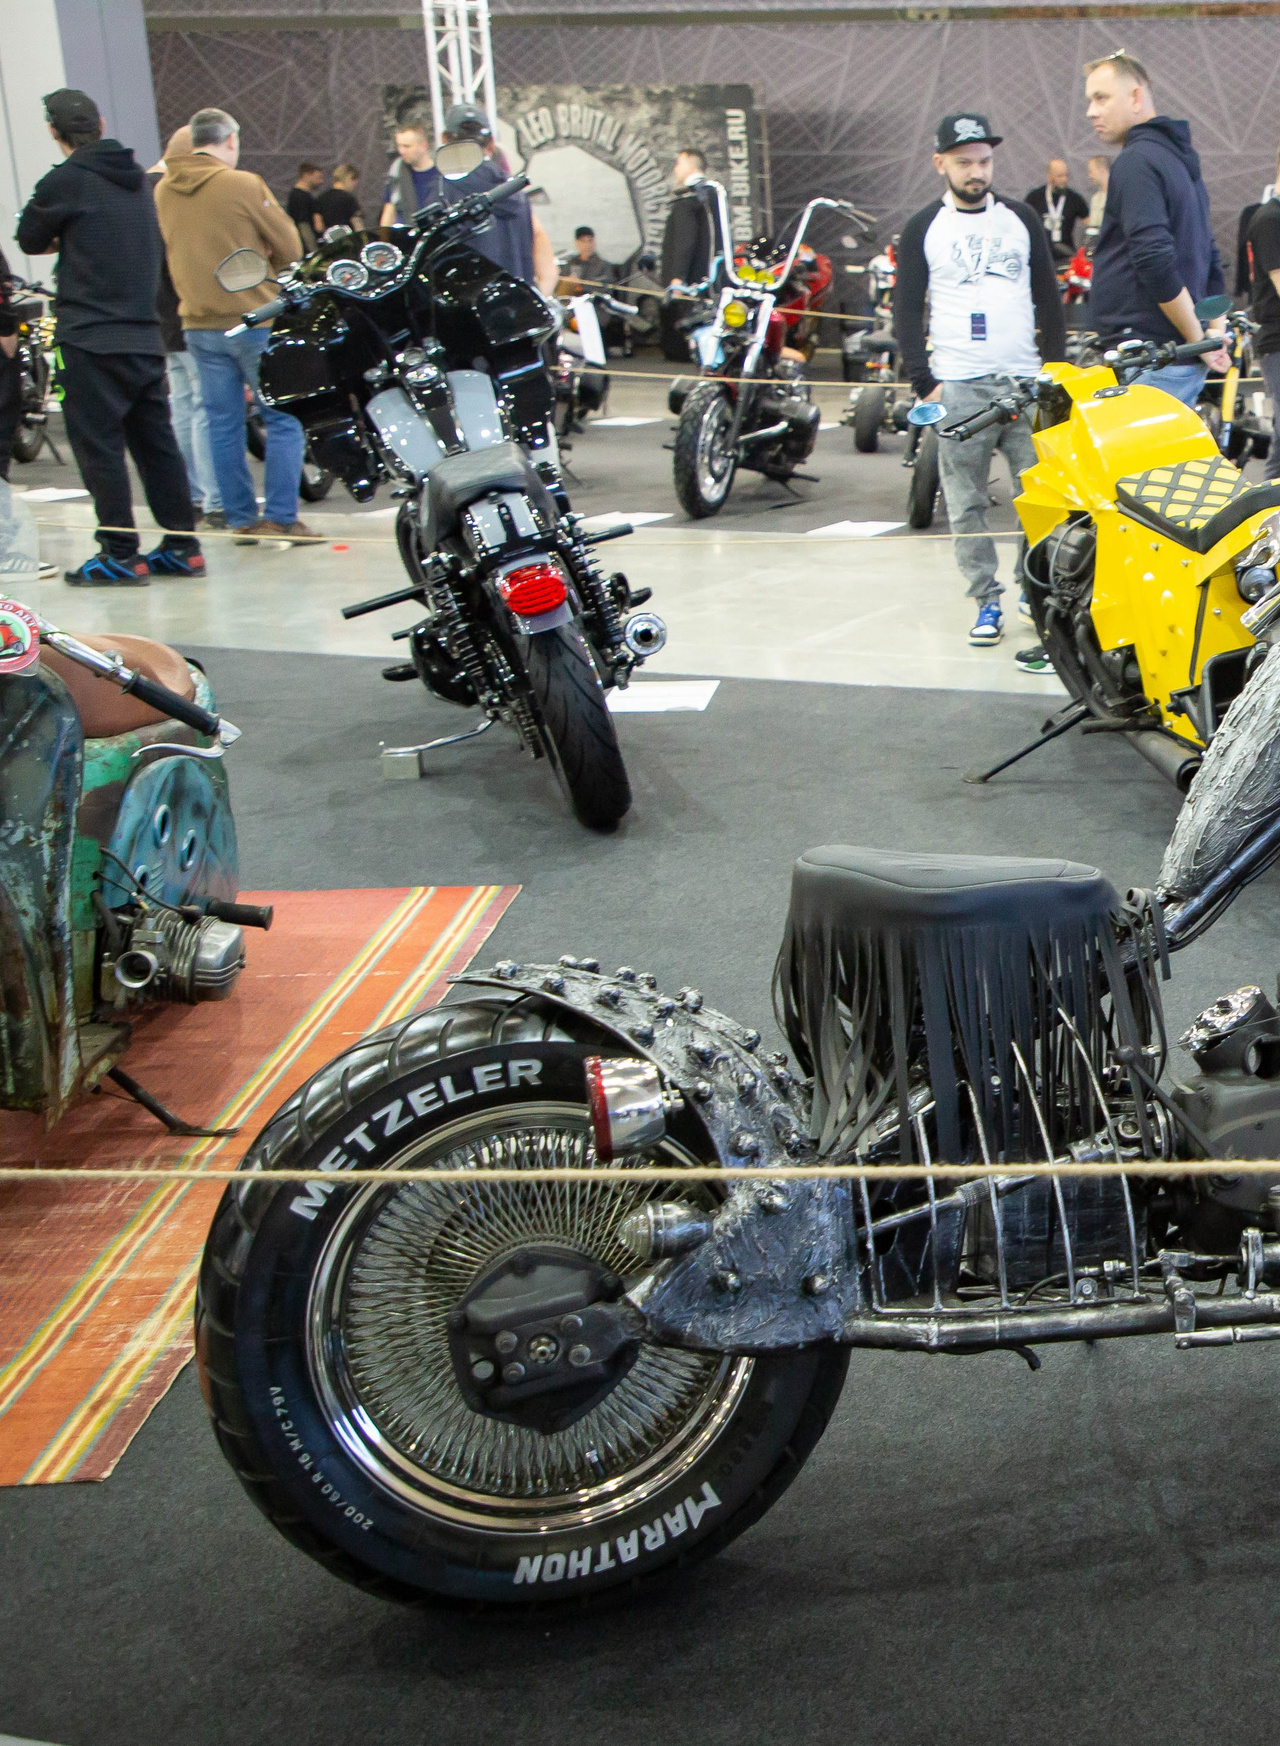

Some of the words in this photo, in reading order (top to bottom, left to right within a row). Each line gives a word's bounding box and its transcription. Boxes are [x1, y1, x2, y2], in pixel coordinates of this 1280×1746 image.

[517, 105, 556, 148] LEO
[556, 103, 623, 151] BRUTAL
[289, 1058, 543, 1222] METZELER
[269, 1386, 289, 1418] 79V
[280, 1420, 304, 1452] M/C
[311, 1472, 324, 1484] R
[513, 1480, 723, 1585] MARATHON
